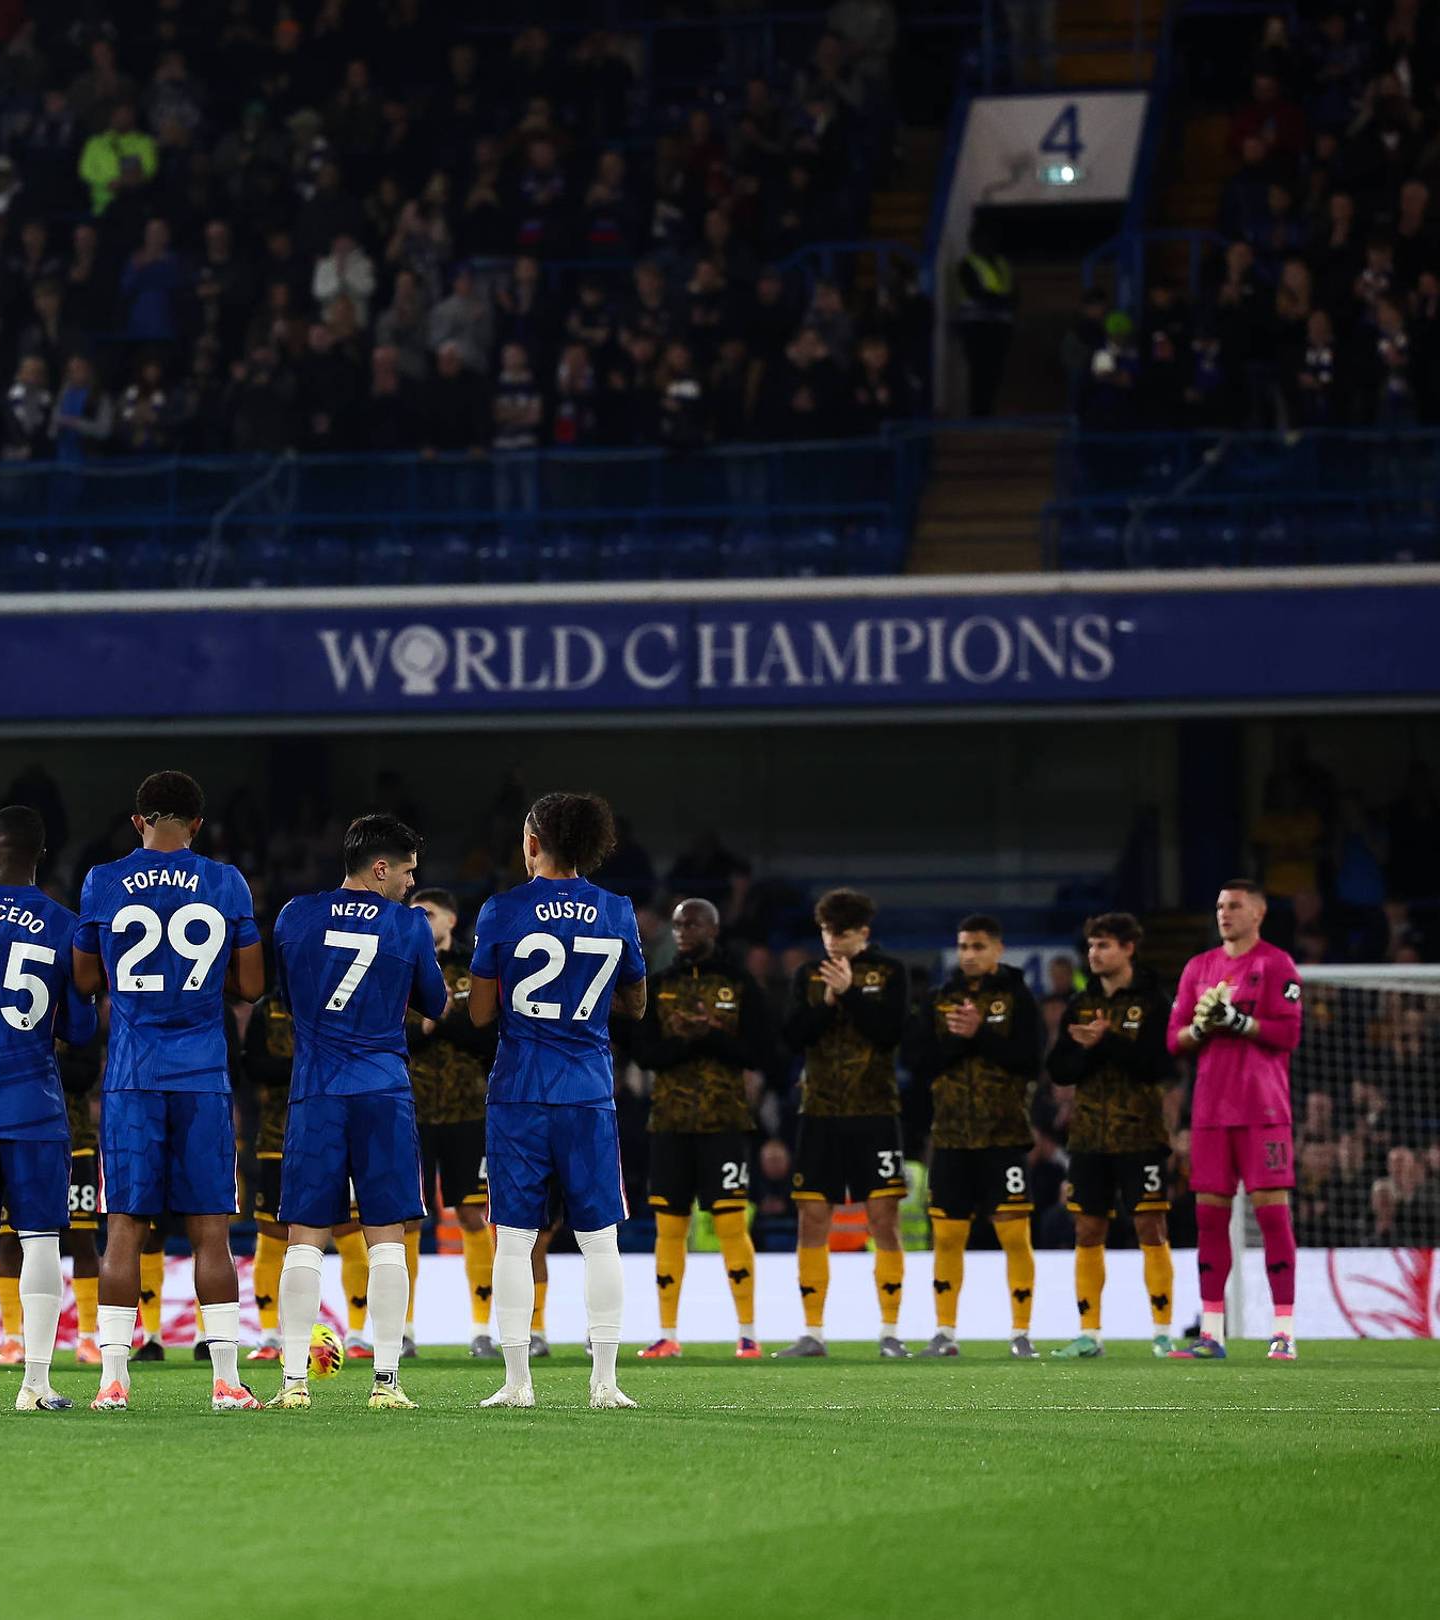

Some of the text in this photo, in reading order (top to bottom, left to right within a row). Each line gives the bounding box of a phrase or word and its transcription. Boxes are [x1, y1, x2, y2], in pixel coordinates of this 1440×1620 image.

[1039, 103, 1087, 162] 4
[623, 614, 1115, 690] CHAMPIONS
[121, 869, 199, 894] FOFANA
[331, 902, 379, 920] NETO
[535, 901, 598, 923] GUSTO
[111, 902, 227, 992] 29
[323, 929, 380, 1011] 7
[511, 932, 623, 1021] 27
[1264, 1142, 1288, 1170] 31
[721, 1162, 749, 1190] 24
[1006, 1166, 1025, 1194] 8
[1144, 1165, 1160, 1192] 3
[68, 1184, 96, 1212] 38
